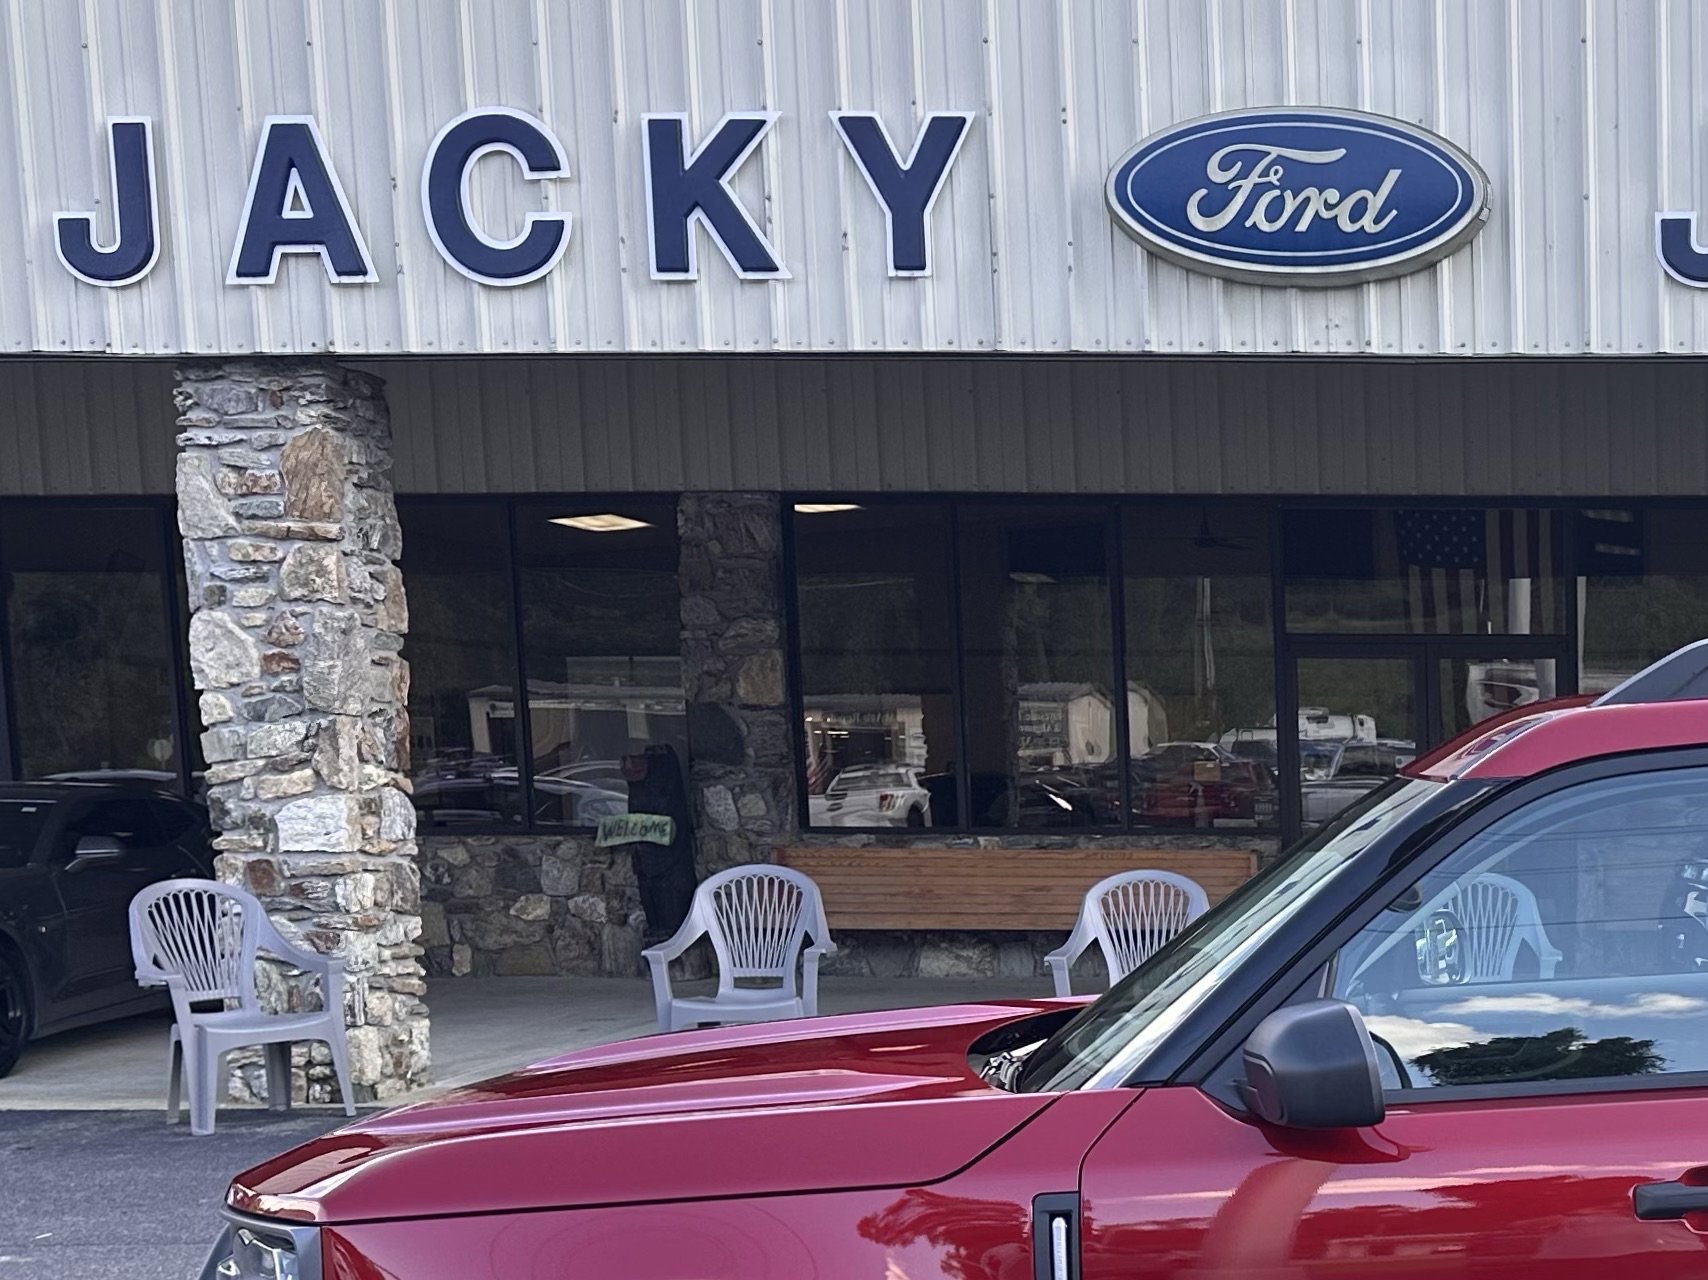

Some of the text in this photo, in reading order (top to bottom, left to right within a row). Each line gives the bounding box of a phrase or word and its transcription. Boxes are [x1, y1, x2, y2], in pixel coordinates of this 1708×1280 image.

[53, 107, 975, 287] JACKY
[1186, 143, 1403, 234] Ford
[602, 820, 669, 841] WELCOME
